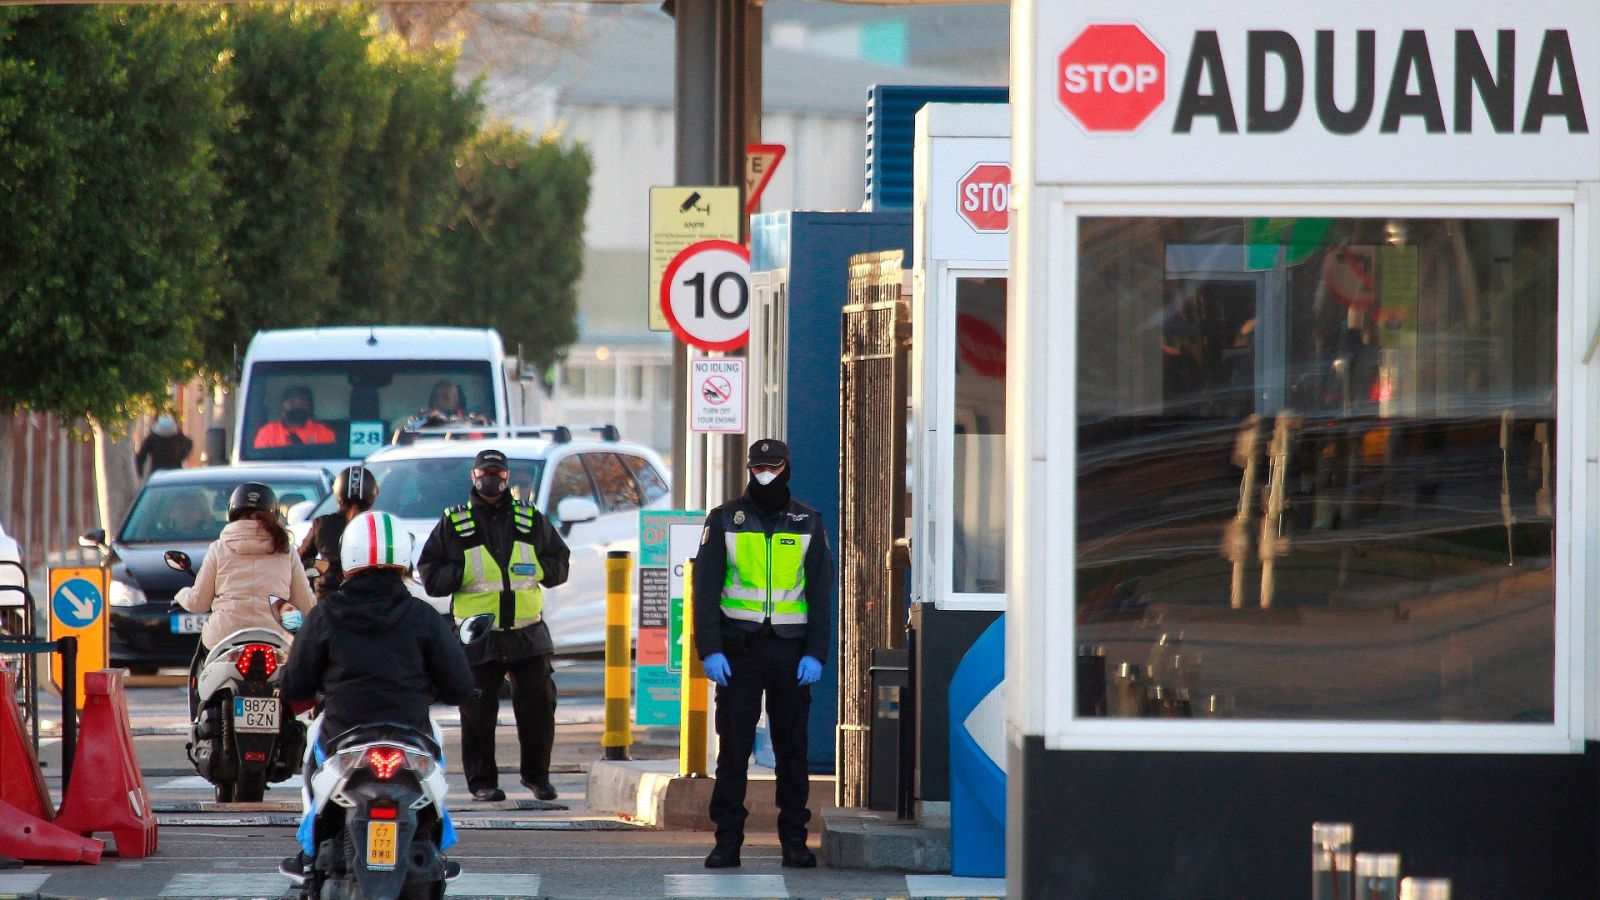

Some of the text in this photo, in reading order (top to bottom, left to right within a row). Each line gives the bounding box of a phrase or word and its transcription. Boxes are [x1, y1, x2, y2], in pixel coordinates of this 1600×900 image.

[1064, 64, 1159, 93] STOP
[1172, 29, 1589, 134] ADUANA
[964, 182, 1010, 212] STO
[683, 271, 749, 320] 10
[695, 362, 739, 373] NO IDLING
[703, 407, 718, 415] TURN
[697, 417, 737, 425] YOUR ENGINE
[353, 431, 380, 445] 28
[244, 699, 277, 713] 9873
[246, 713, 274, 727] GZN
[373, 839, 391, 849] 177
